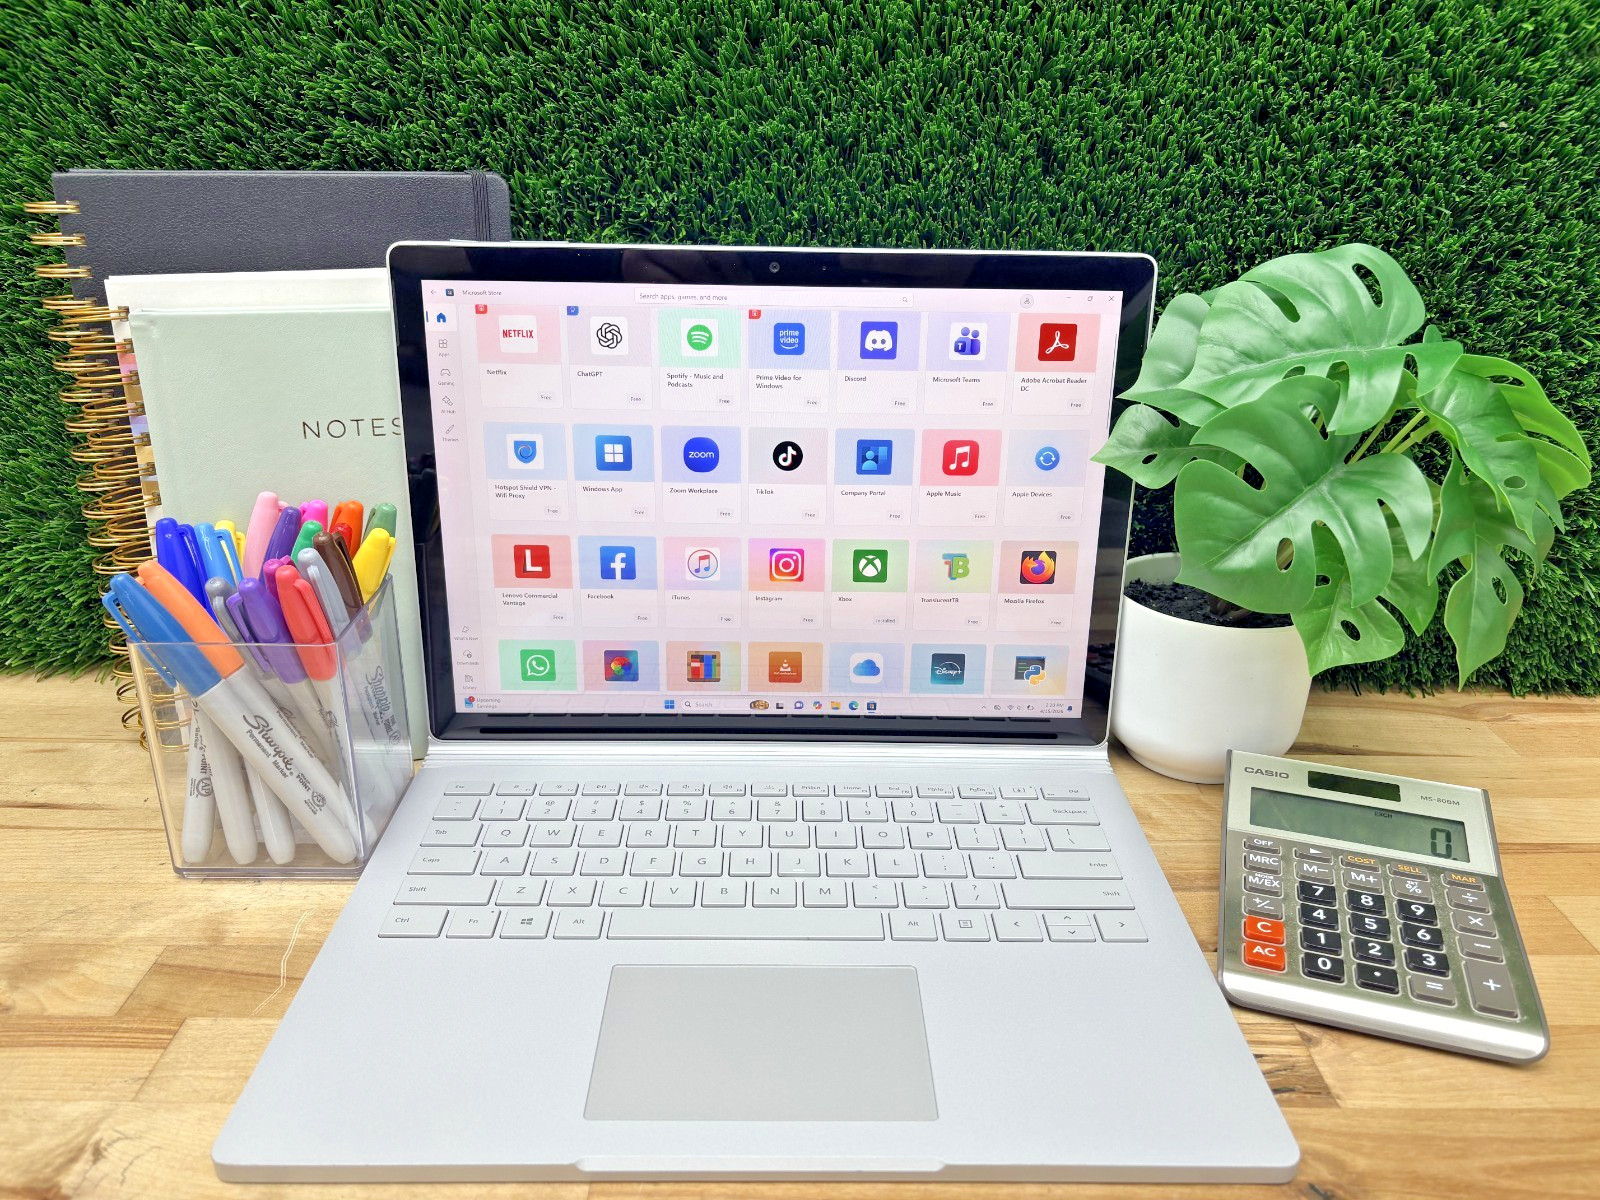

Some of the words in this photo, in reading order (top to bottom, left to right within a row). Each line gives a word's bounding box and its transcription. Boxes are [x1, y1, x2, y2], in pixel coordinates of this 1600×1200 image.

[639, 292, 659, 300] Search
[502, 329, 534, 339] NETFLIX
[779, 329, 800, 337] prime
[302, 417, 402, 440] NOTES
[494, 484, 518, 492] Hotspot
[508, 492, 525, 500] Proxy
[242, 714, 294, 771] Sharpie
[246, 729, 272, 758] Permanent
[272, 760, 289, 779] Marker
[1244, 766, 1290, 779] CASIO
[296, 774, 311, 792] POINT
[500, 829, 511, 838] Q
[1253, 838, 1274, 846] OFF
[844, 858, 852, 866] K
[894, 858, 900, 866] L
[1249, 854, 1279, 865] MRC
[1348, 855, 1376, 864] COST
[1398, 864, 1422, 874] SELL
[1248, 876, 1280, 888] M/EX
[1351, 872, 1378, 883] M+
[1451, 874, 1477, 884] MAR
[516, 886, 526, 894] Z
[568, 886, 577, 894] X
[618, 886, 628, 895] C
[1312, 886, 1324, 896] 7
[1360, 894, 1374, 906] 8
[1312, 909, 1326, 920] 4
[1410, 904, 1425, 916] 9
[1256, 922, 1272, 933] C
[1364, 918, 1378, 930] 5
[1316, 932, 1326, 944] 1
[1416, 928, 1431, 941] 6
[1252, 946, 1277, 957] AC
[1368, 943, 1382, 956] 2
[1317, 958, 1332, 970] 0
[1422, 954, 1436, 966] 3
